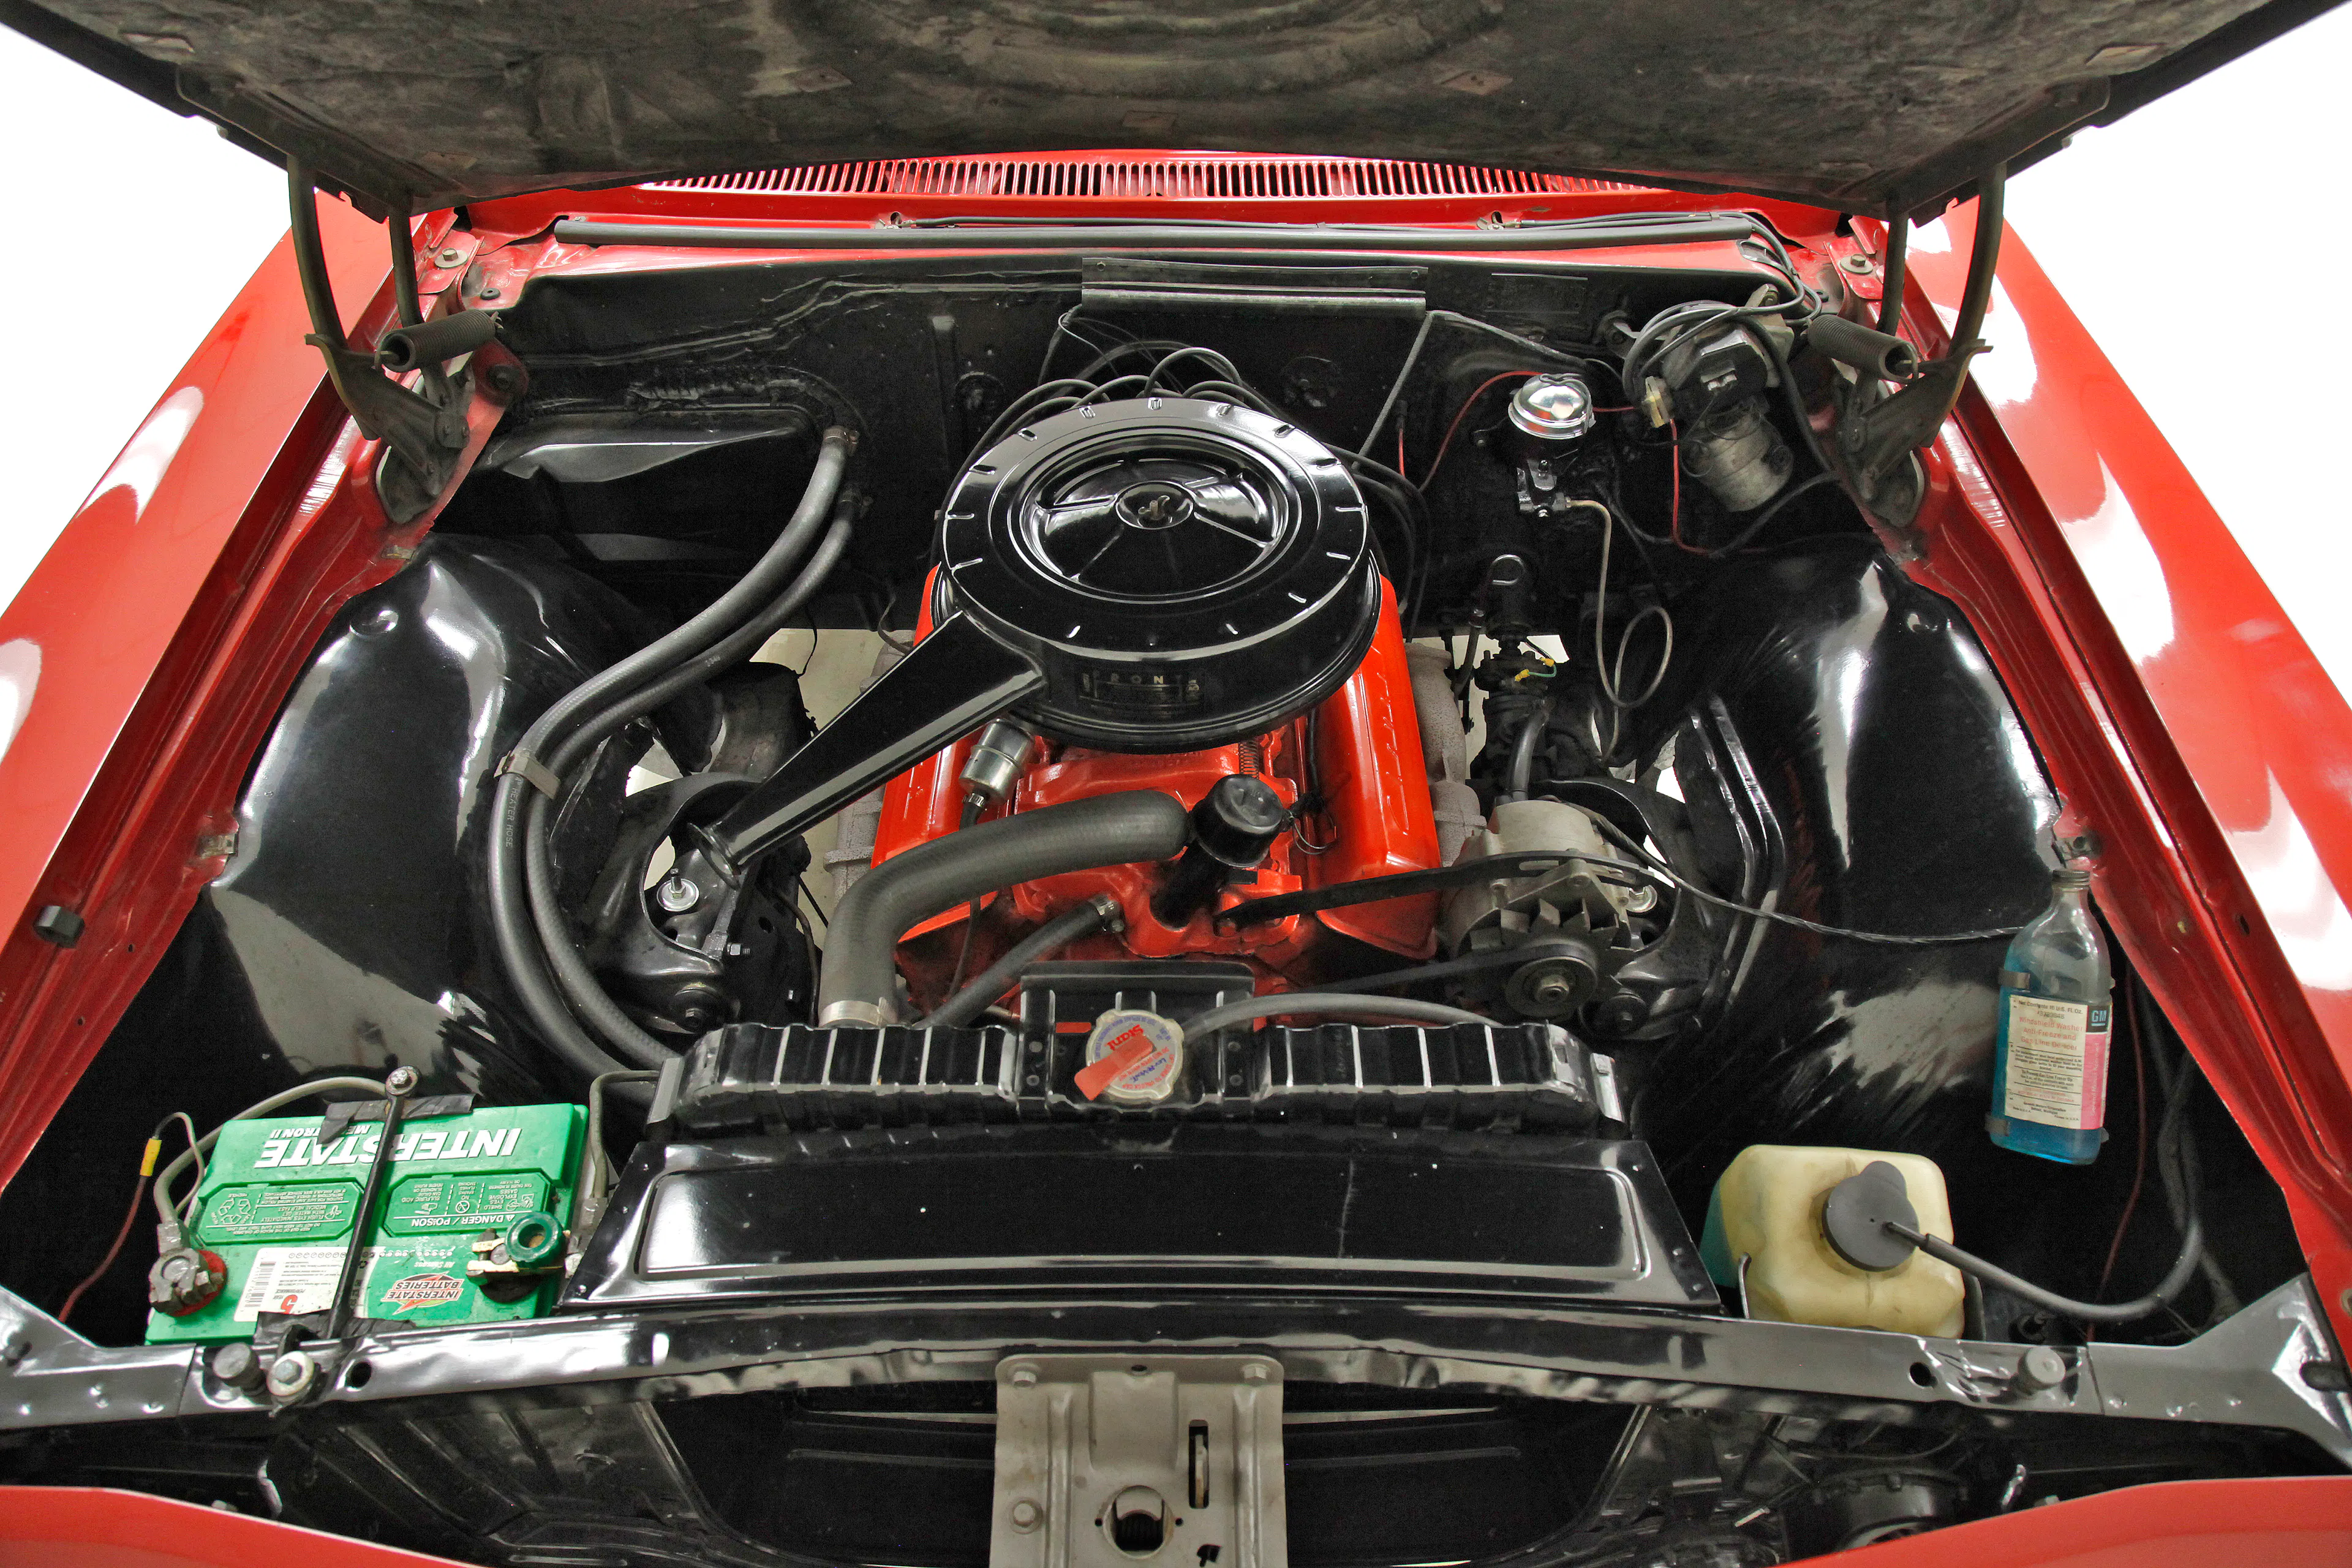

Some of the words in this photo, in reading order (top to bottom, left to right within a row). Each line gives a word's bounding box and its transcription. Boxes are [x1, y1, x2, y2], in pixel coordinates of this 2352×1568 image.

[690, 606, 717, 627] HEATER
[671, 626, 690, 639] HOSE
[507, 787, 521, 821] HEATER
[505, 824, 514, 848] HOSE
[2092, 1010, 2107, 1022] GM
[2019, 1017, 2054, 1028] Windshield
[2056, 1023, 2082, 1031] Washer
[2023, 1028, 2062, 1039] Anti-Freeze
[1135, 1080, 1155, 1090] UNLOCK
[411, 1218, 451, 1227] POISON
[462, 1214, 504, 1225] DANGER
[387, 1291, 459, 1299] INTERSTATE
[280, 1294, 298, 1314] 5
